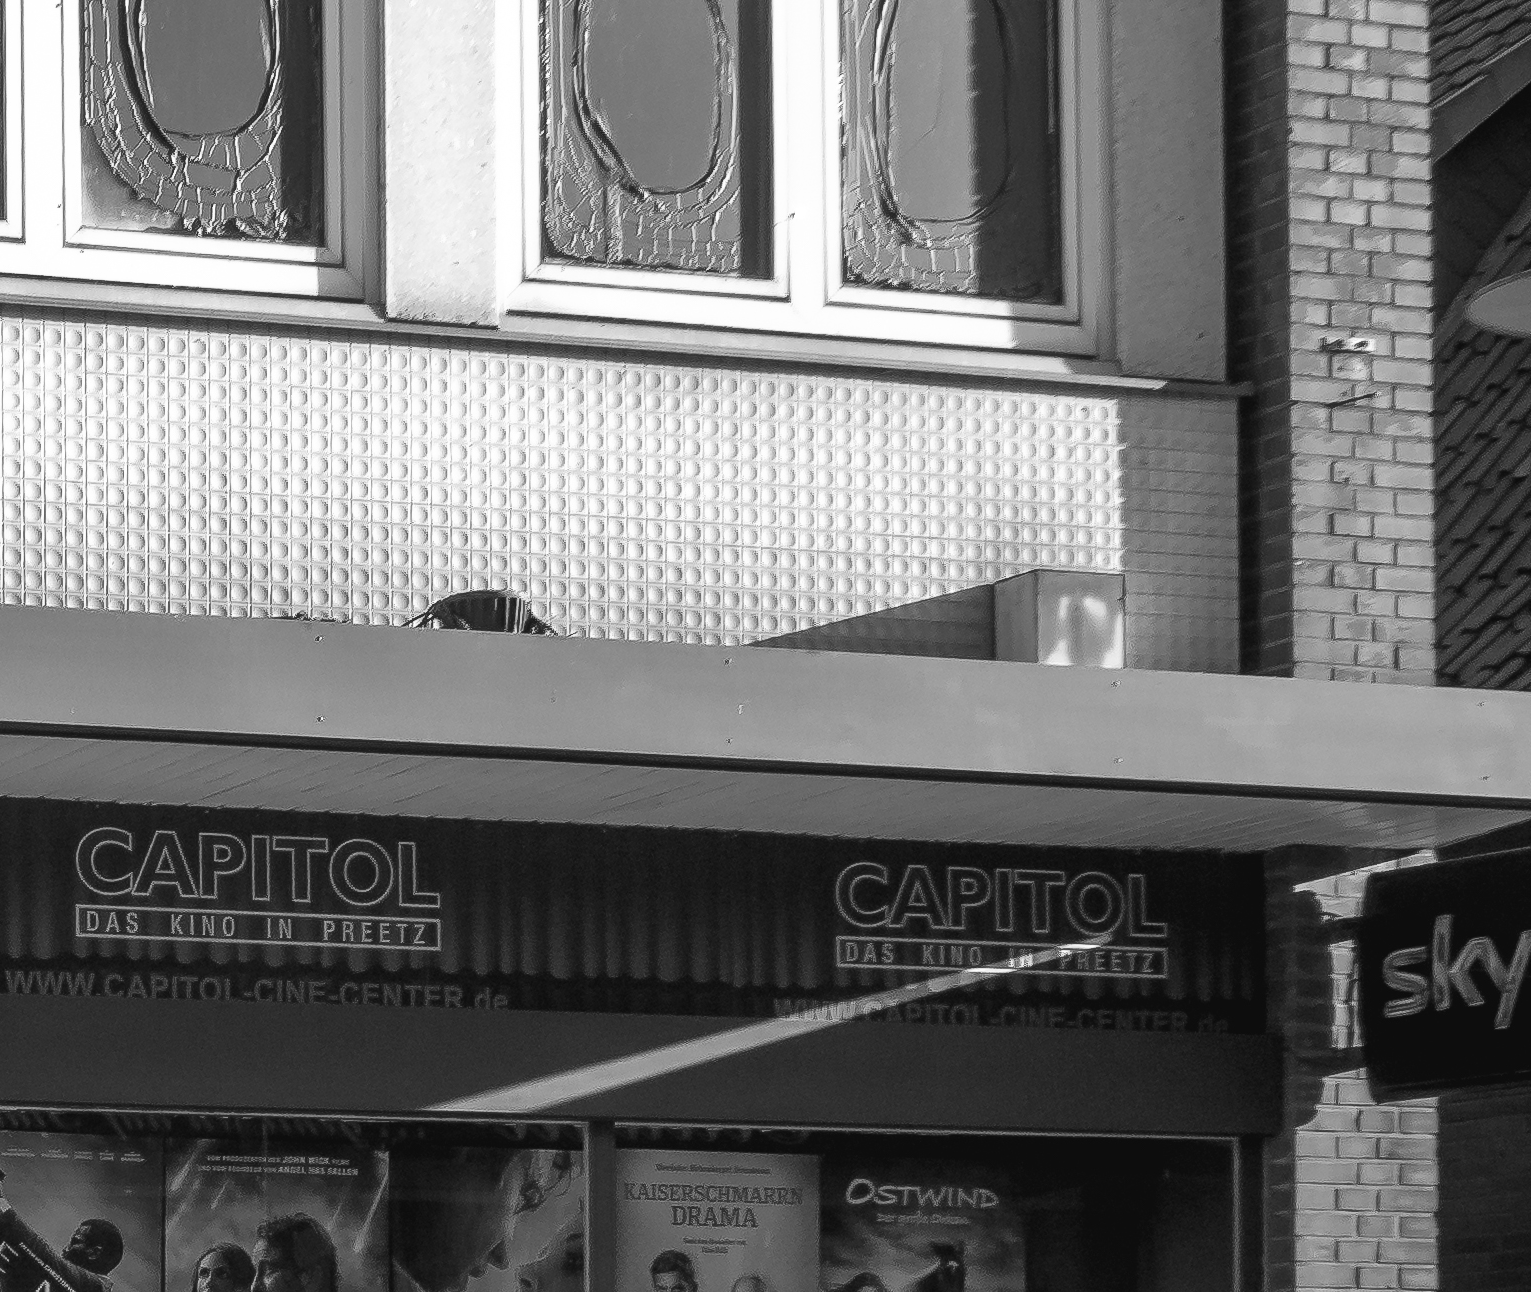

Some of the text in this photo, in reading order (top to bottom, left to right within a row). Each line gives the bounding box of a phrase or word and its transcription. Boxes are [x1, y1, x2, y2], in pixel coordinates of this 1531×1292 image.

[75, 826, 441, 908] CAPITOL
[85, 910, 427, 945] DAS KINO IN PREETZ
[835, 861, 1168, 938] CAPITOL
[845, 941, 1156, 975] DAS KINO IN PREETZ
[1381, 914, 1531, 1030] sky
[670, 1205, 759, 1228] DRAMA
